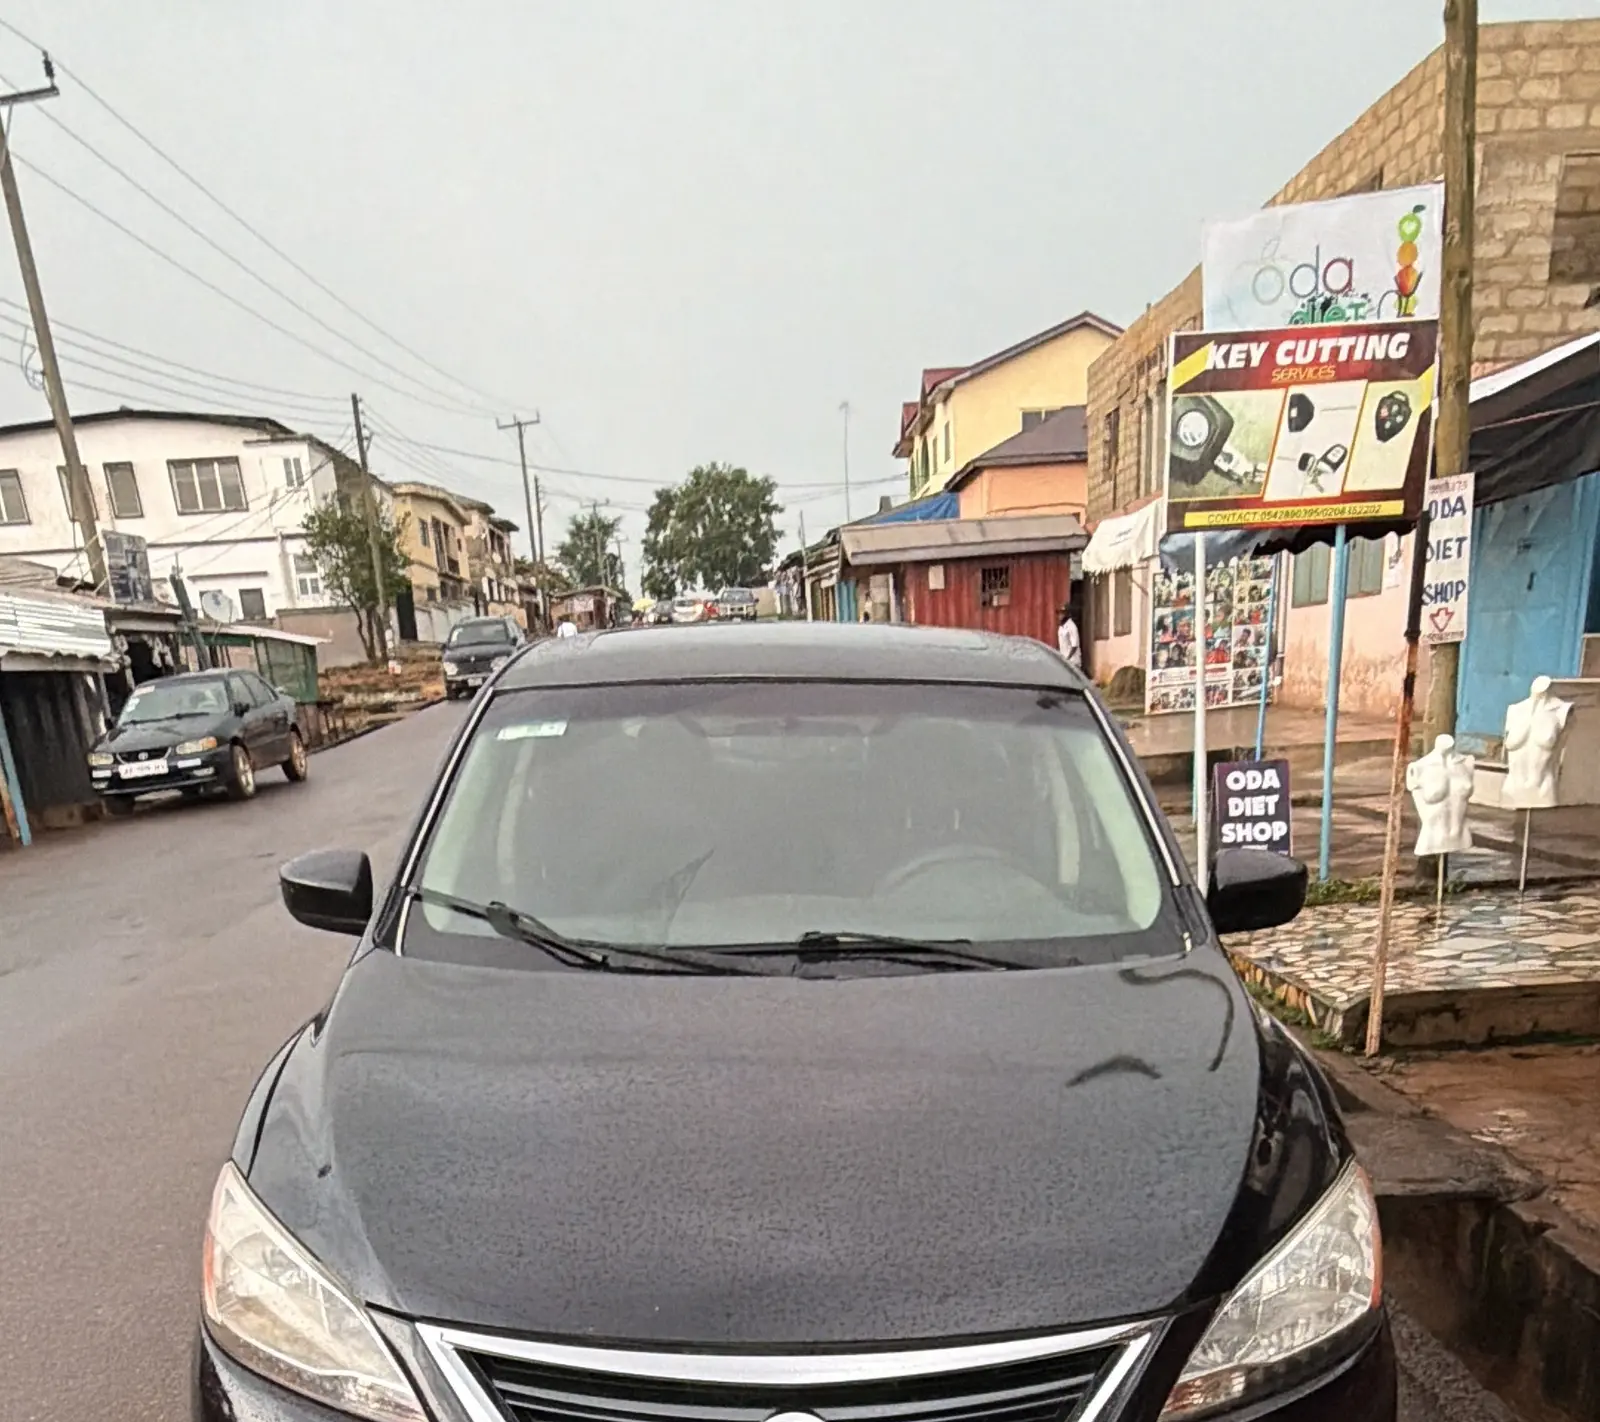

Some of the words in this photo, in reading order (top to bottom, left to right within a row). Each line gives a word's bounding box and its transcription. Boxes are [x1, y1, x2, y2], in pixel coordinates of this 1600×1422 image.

[1252, 244, 1354, 304] oda
[1205, 341, 1269, 370] KEY
[1276, 333, 1410, 365] CUTTING
[1271, 365, 1336, 382] SERVICES
[1428, 496, 1467, 521] ODA
[1426, 536, 1468, 562] DIET
[1421, 579, 1466, 606] SHOP
[1226, 768, 1281, 791] ODA
[1228, 794, 1280, 817] DIET
[1221, 821, 1288, 843] SHOP
